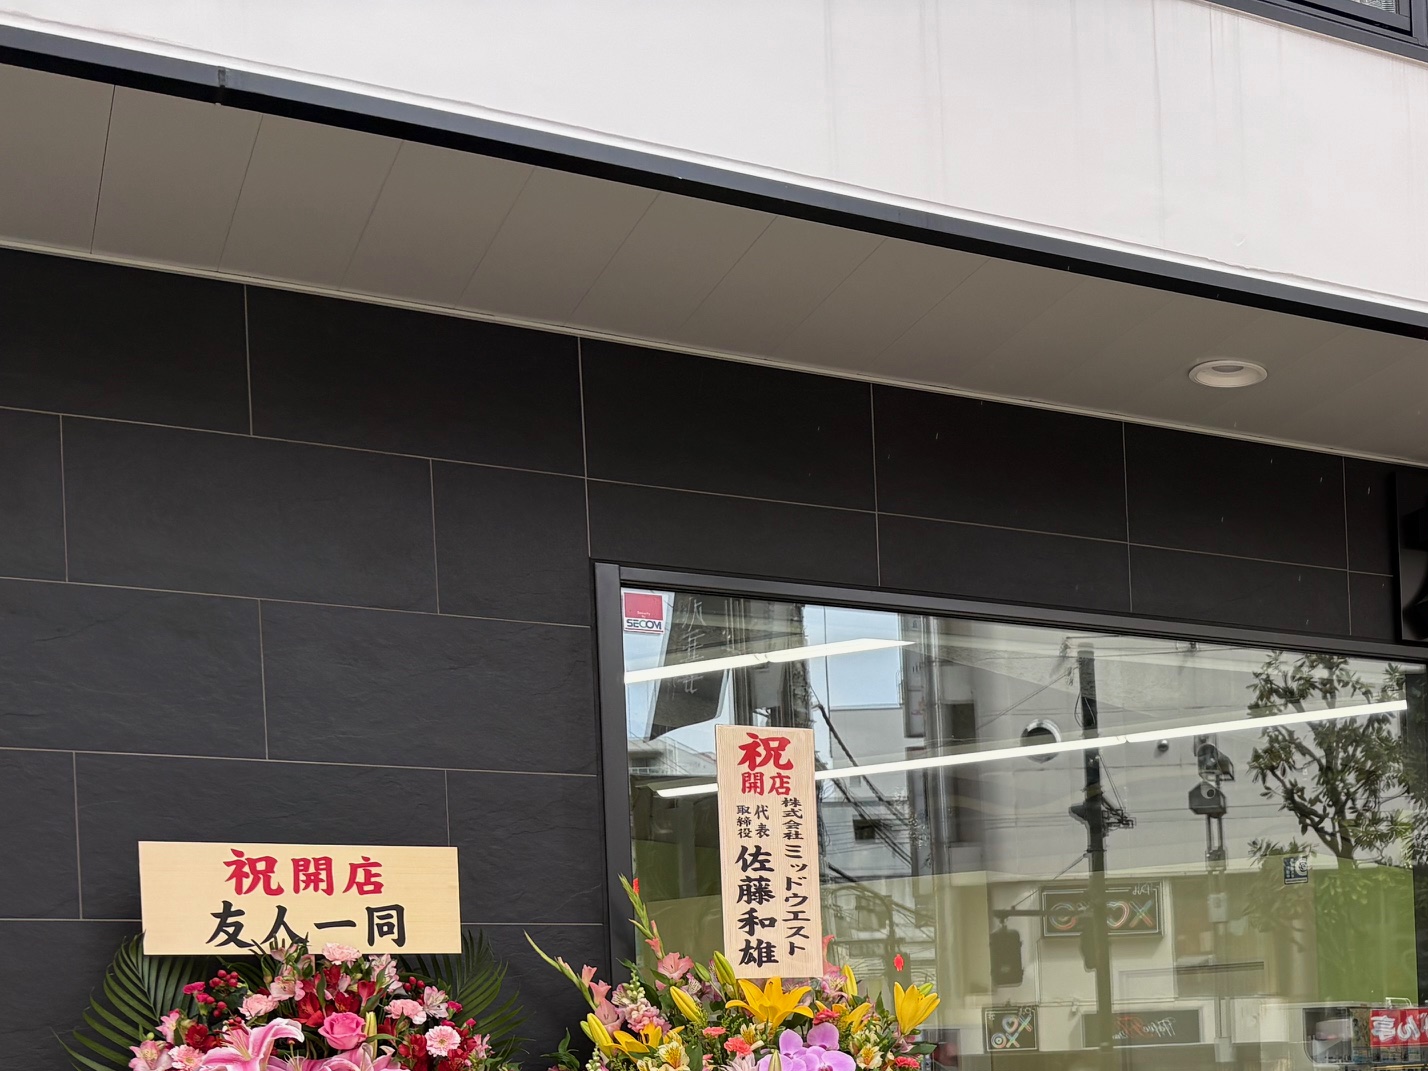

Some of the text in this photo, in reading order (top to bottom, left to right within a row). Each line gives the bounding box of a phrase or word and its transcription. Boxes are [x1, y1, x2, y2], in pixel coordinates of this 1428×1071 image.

[626, 619, 662, 630] SECOM
[737, 732, 794, 771] 祝
[741, 771, 792, 796] 開店
[223, 848, 385, 896] 祝開店
[781, 797, 811, 956] 株式会社ミッドウエスト
[206, 900, 407, 949] 友人一同
[734, 844, 779, 967] 佐藤和雄
